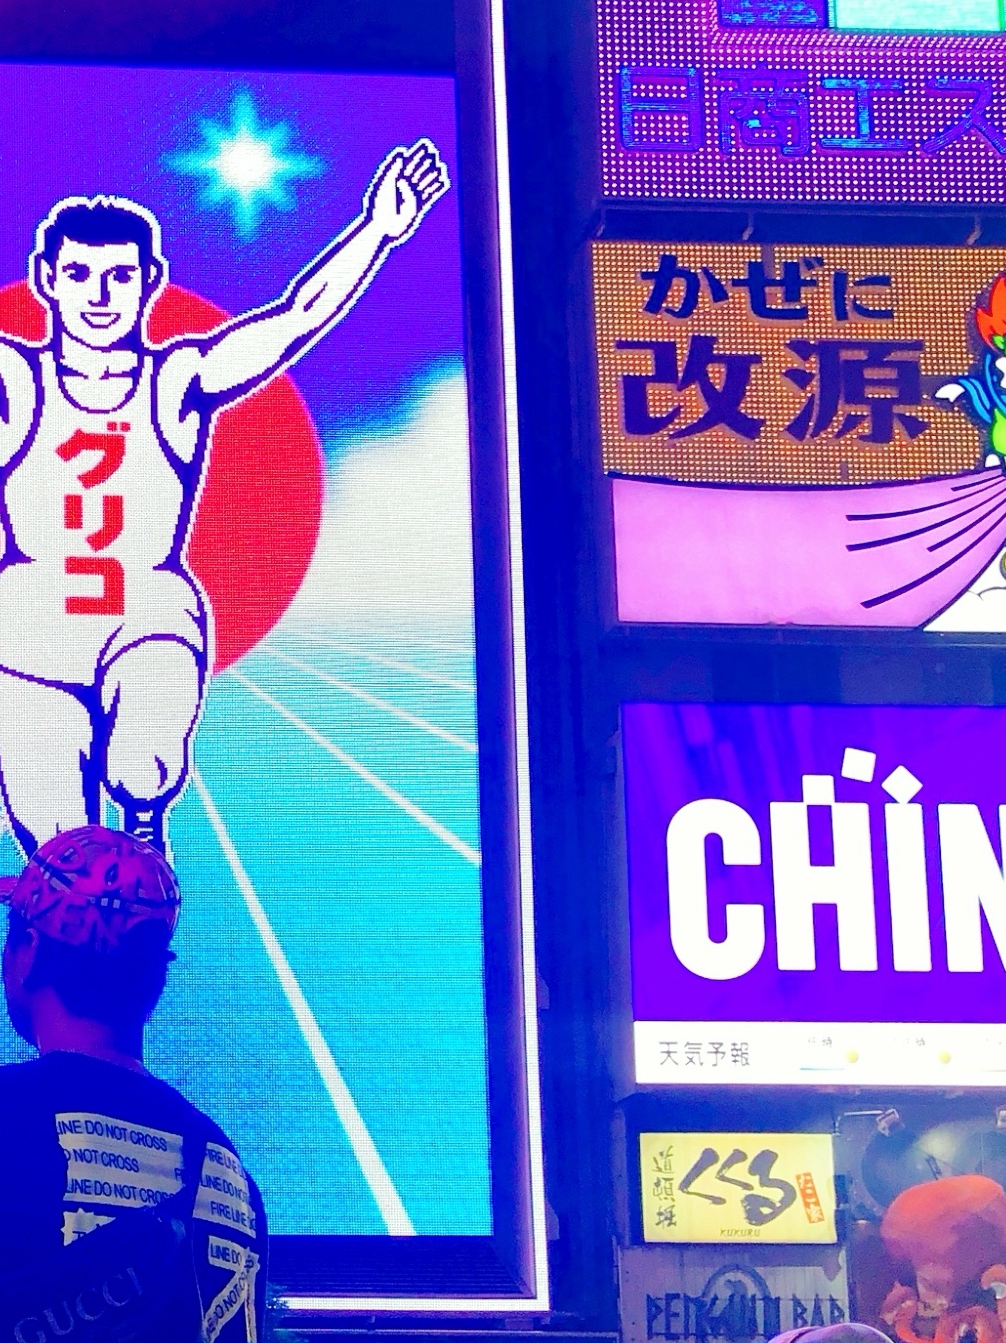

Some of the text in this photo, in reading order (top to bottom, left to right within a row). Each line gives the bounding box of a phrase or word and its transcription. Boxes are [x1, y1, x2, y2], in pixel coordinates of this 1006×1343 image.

[640, 253, 895, 322] かぜに
[614, 336, 930, 445] 改源
[56, 421, 132, 617] グリコ
[658, 1041, 751, 1067] 天気予報
[84, 1119, 104, 1137] DO
[105, 1123, 128, 1142] NOT
[129, 1130, 168, 1152] CROSS
[73, 1148, 99, 1164] NOT
[100, 1151, 140, 1174] CROSS
[94, 1180, 113, 1197] DO
[113, 1183, 138, 1201] NOT
[200, 1174, 223, 1193] LINE
[223, 1178, 235, 1197] DO
[678, 1147, 797, 1227] くくる
[210, 1200, 232, 1221] FIRE
[720, 1228, 762, 1238] KUKURU
[210, 1243, 231, 1263] LINE
